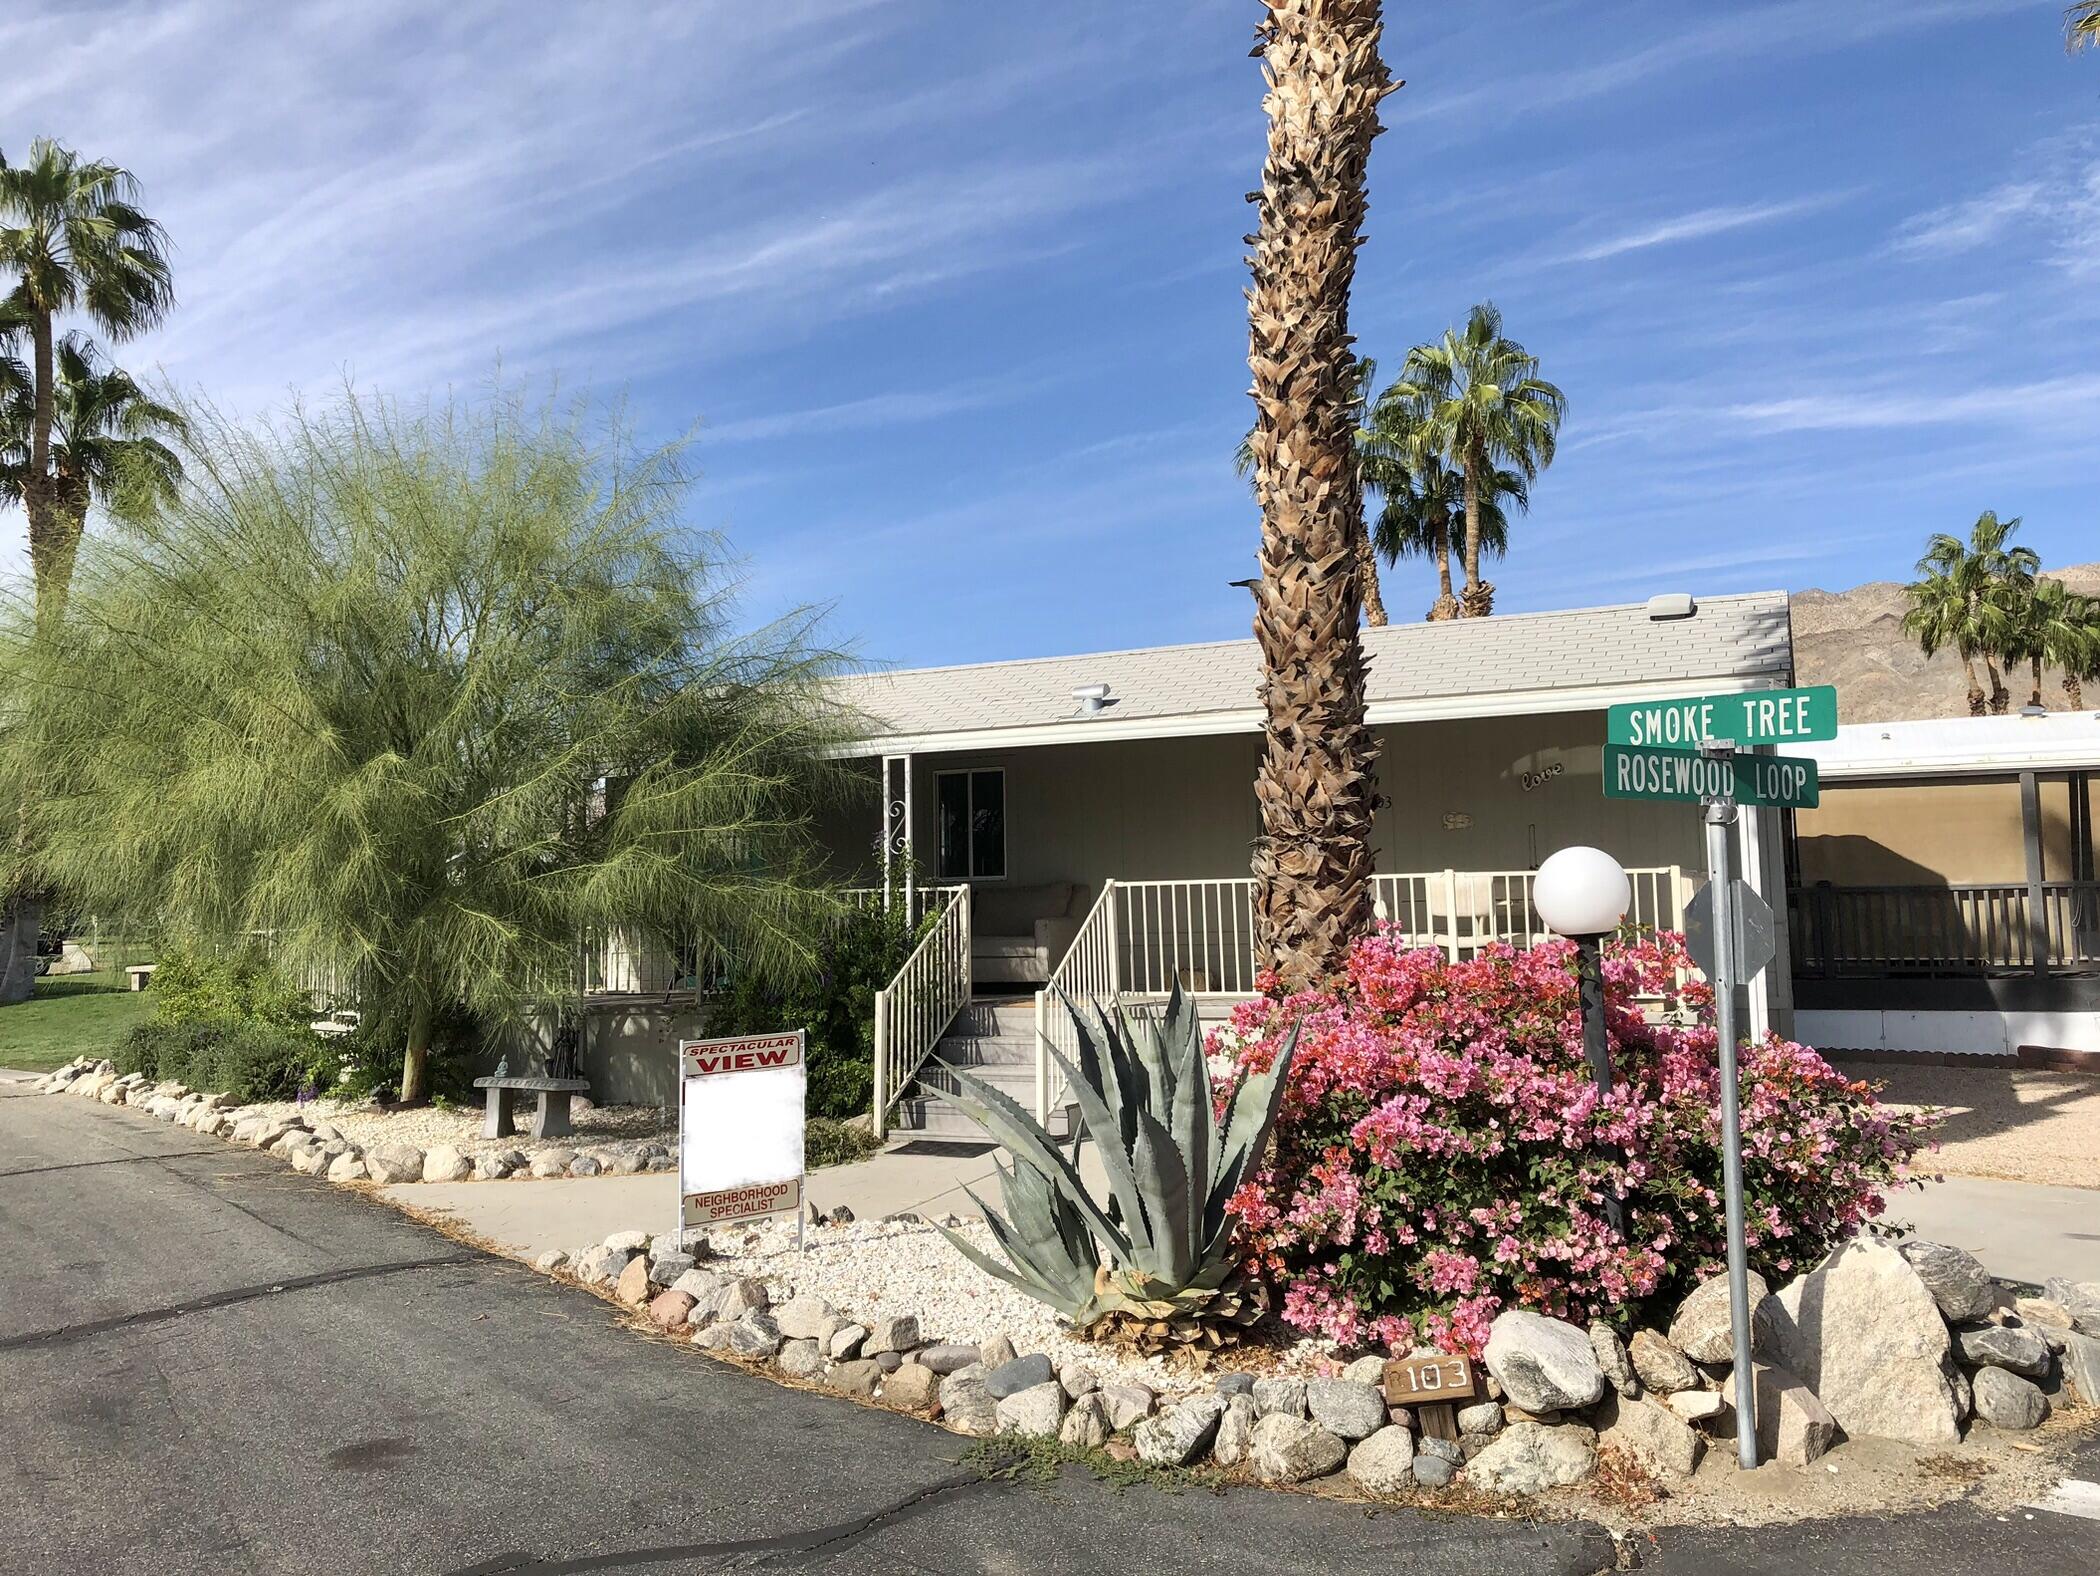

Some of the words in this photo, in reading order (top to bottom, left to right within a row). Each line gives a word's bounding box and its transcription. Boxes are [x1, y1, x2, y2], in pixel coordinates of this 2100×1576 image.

[1629, 703, 1715, 746] SMOKE
[1743, 696, 1812, 738] TREE
[1617, 753, 1735, 797] ROSEWOOD
[1756, 763, 1806, 801] LOOP
[689, 1038, 795, 1057] SPECTACULAR
[696, 1049, 788, 1073] VIEW
[695, 1184, 788, 1209] NEIGHBORHOOD
[710, 1198, 775, 1219] SPECIALIST
[1406, 1360, 1467, 1392] 103
